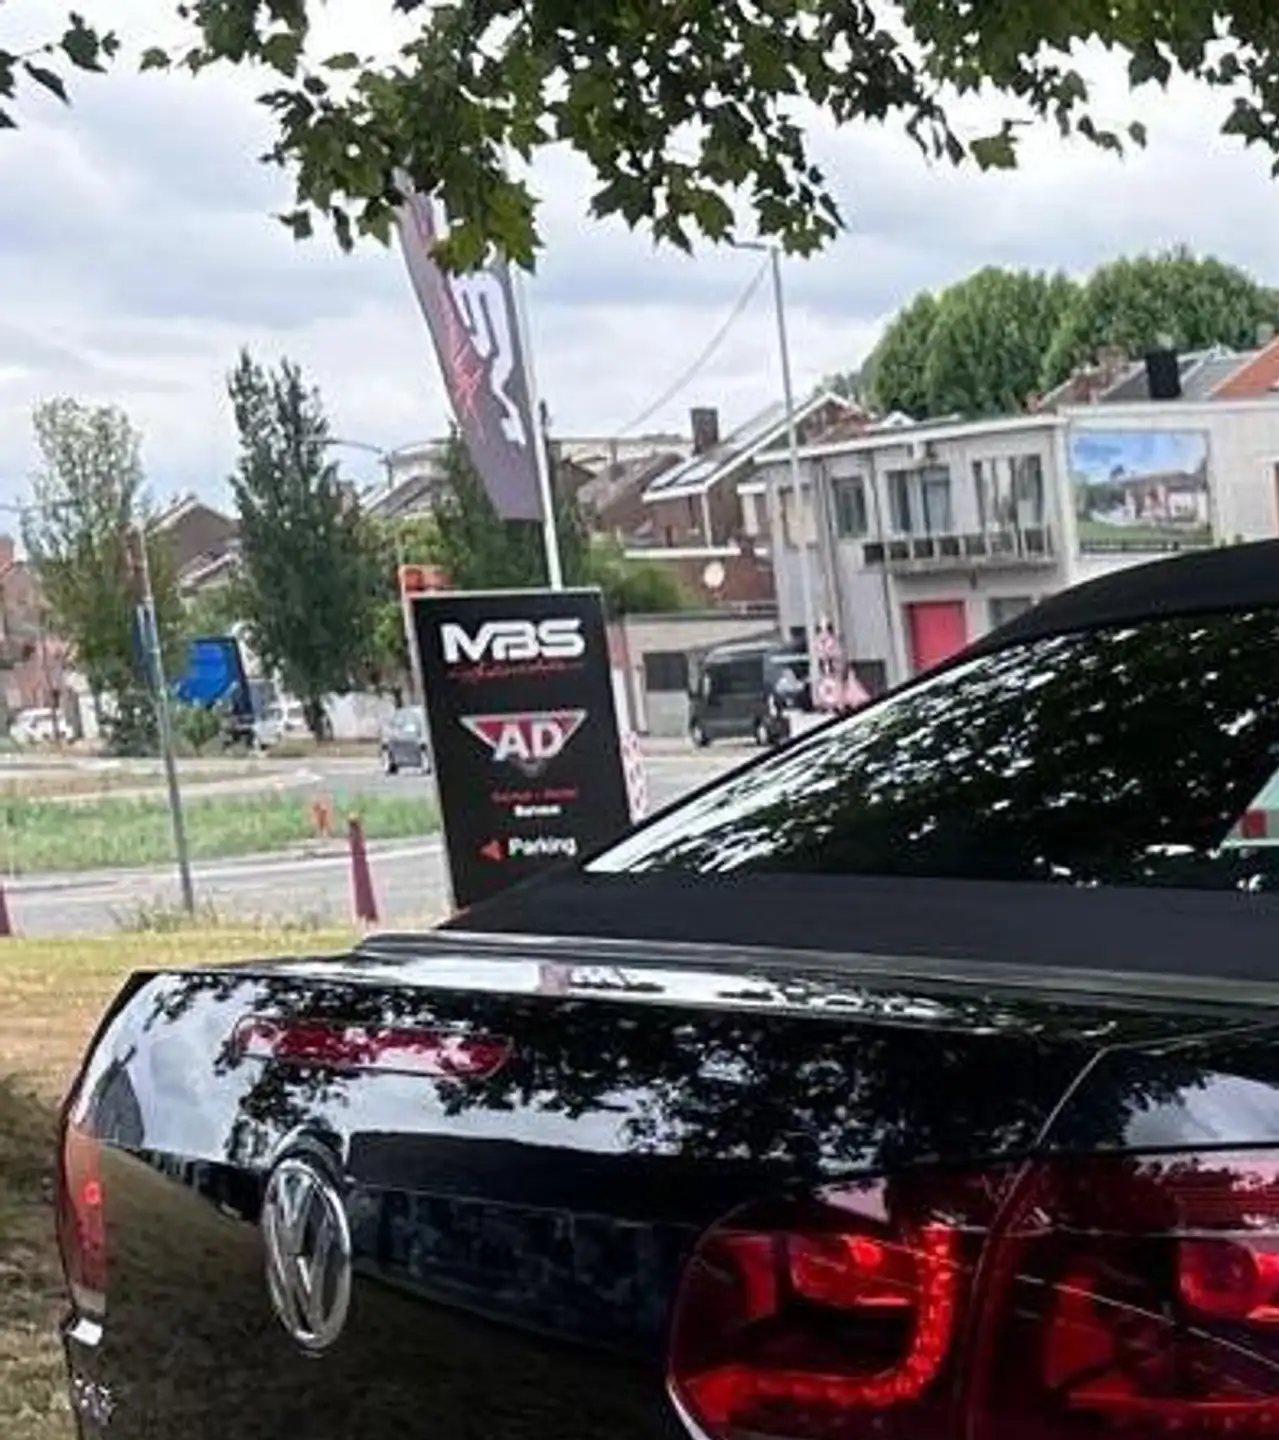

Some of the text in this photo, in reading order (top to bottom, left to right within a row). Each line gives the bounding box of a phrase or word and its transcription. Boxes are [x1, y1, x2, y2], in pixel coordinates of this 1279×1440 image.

[440, 617, 586, 663] MBS
[494, 721, 565, 762] AD
[508, 835, 577, 857] Parking
